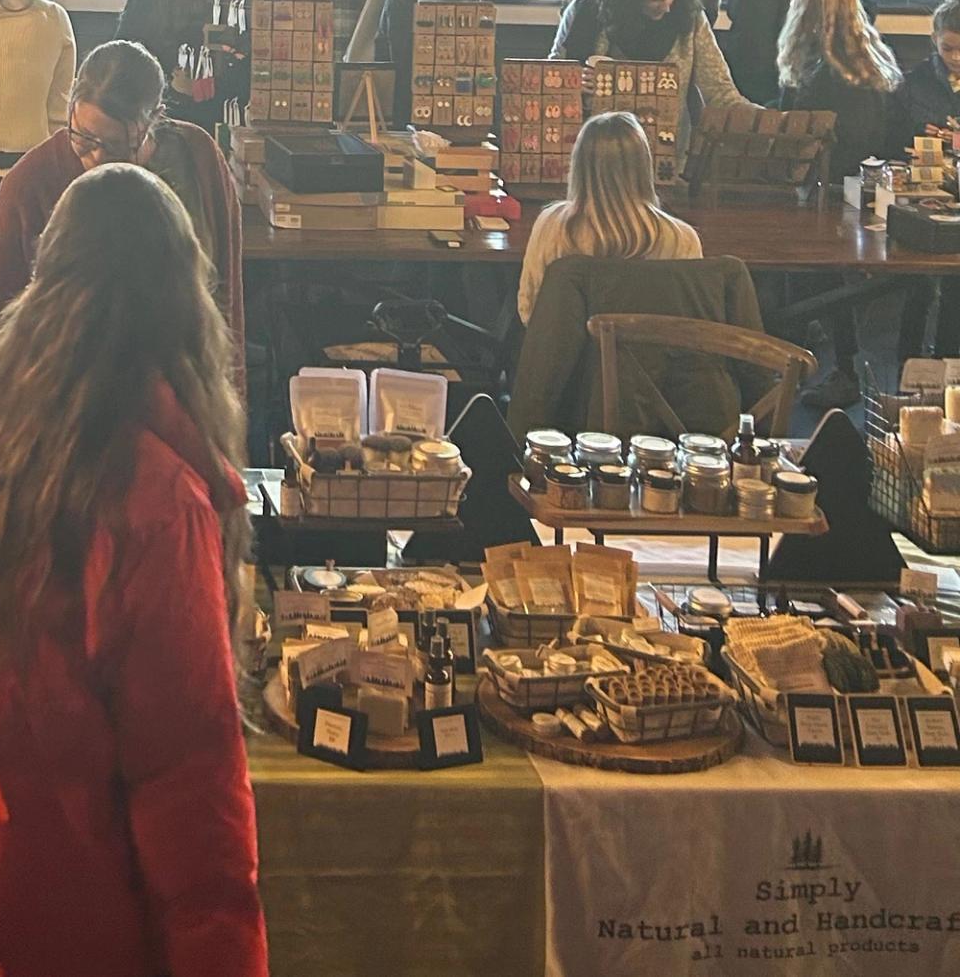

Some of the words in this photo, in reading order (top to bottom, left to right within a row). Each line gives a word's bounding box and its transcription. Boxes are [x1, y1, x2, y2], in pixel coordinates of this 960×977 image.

[756, 877, 862, 904] Simply
[598, 916, 724, 942] Natural
[744, 914, 800, 936] and
[691, 945, 724, 961] all
[738, 941, 817, 960] natural
[828, 938, 920, 957] products
